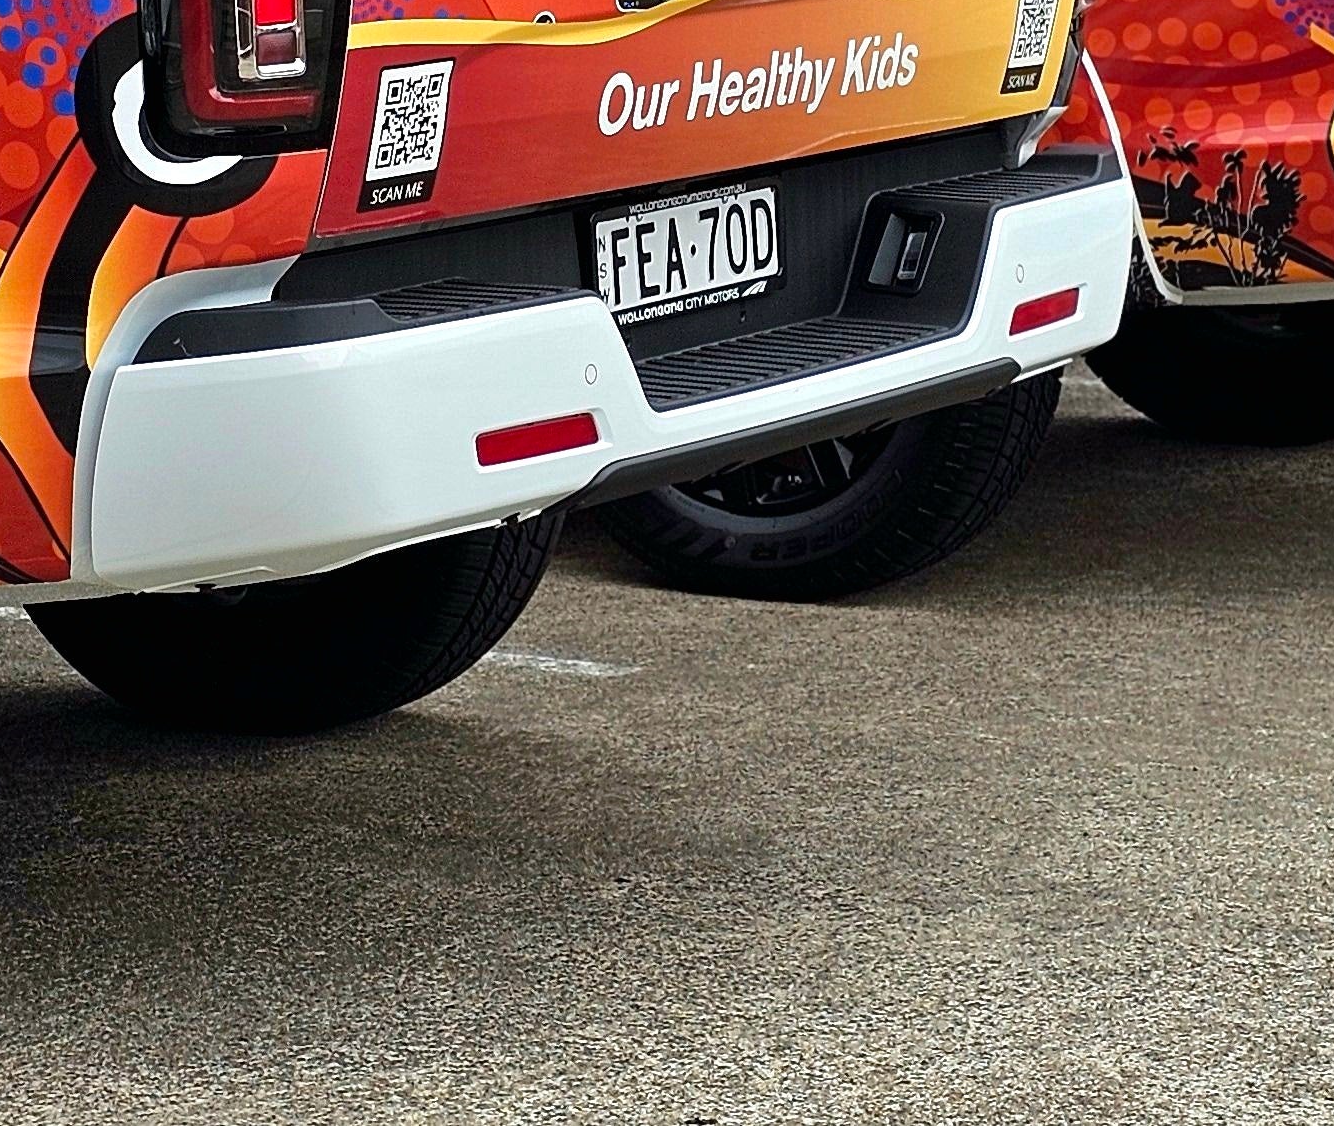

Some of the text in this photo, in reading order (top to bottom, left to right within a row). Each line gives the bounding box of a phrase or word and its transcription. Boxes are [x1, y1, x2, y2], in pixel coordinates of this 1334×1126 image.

[597, 31, 921, 137] Our Healthy Kids
[370, 180, 425, 205] SCAN ME
[685, 294, 704, 310] CITY
[704, 287, 740, 306] MOTORS
